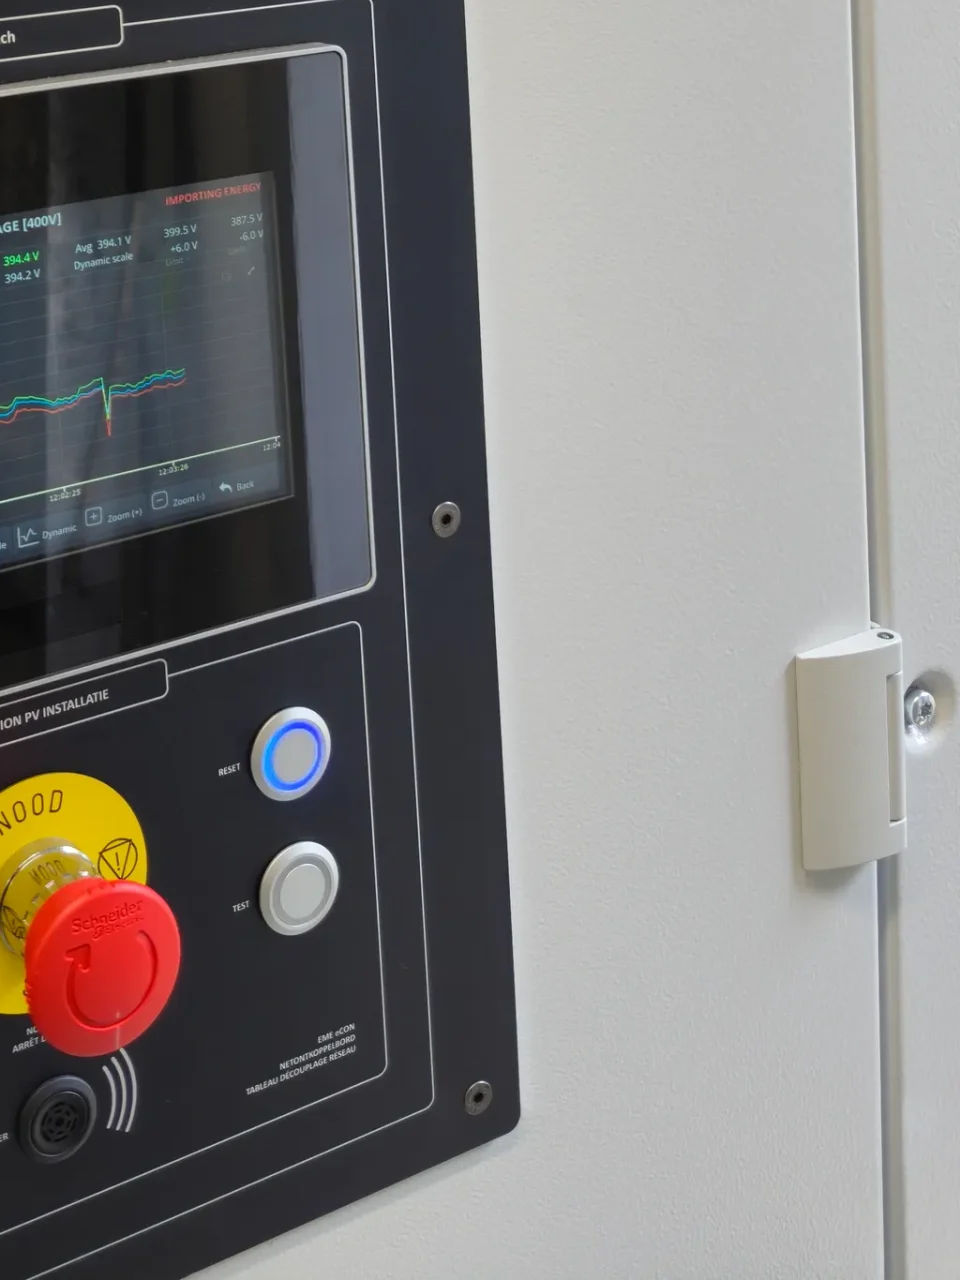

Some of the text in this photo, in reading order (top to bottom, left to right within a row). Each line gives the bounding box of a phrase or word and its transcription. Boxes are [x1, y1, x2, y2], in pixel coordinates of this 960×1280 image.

[165, 182, 262, 206] IMPORTING ENERGY
[23, 212, 62, 233] [400V]
[3, 252, 31, 266] 394.4
[31, 251, 40, 262] V
[75, 242, 93, 255] Avg
[97, 237, 123, 250] 394.1
[124, 235, 132, 245] V
[163, 225, 190, 238] 399.5
[189, 224, 197, 234] V
[231, 214, 255, 226] 387.5
[255, 212, 263, 222] V
[4, 270, 32, 284] 394.2
[32, 269, 40, 279] V
[74, 256, 111, 271] Dynamic
[112, 251, 133, 264] scale
[170, 242, 190, 254] +6.0
[190, 240, 198, 250] V
[256, 228, 264, 238] V
[49, 489, 82, 502] 12:02:25
[236, 480, 254, 491] Back
[173, 493, 206, 507] Zoom (-)
[107, 508, 143, 523] Zoom (+)
[42, 524, 78, 540] Dynamic
[24, 709, 41, 725] PV
[43, 688, 110, 719] INSTALLATIE
[217, 762, 241, 777] RESET
[71, 899, 144, 933] Schneider
[232, 900, 250, 913] TEST
[317, 1023, 356, 1044] EME eCON
[12, 1036, 40, 1054] ARRÊT
[279, 1034, 356, 1071] NETONTKOPPELBORD
[246, 1045, 357, 1096] TABLEAU DÉCOUPLAGE RÉSEAU
